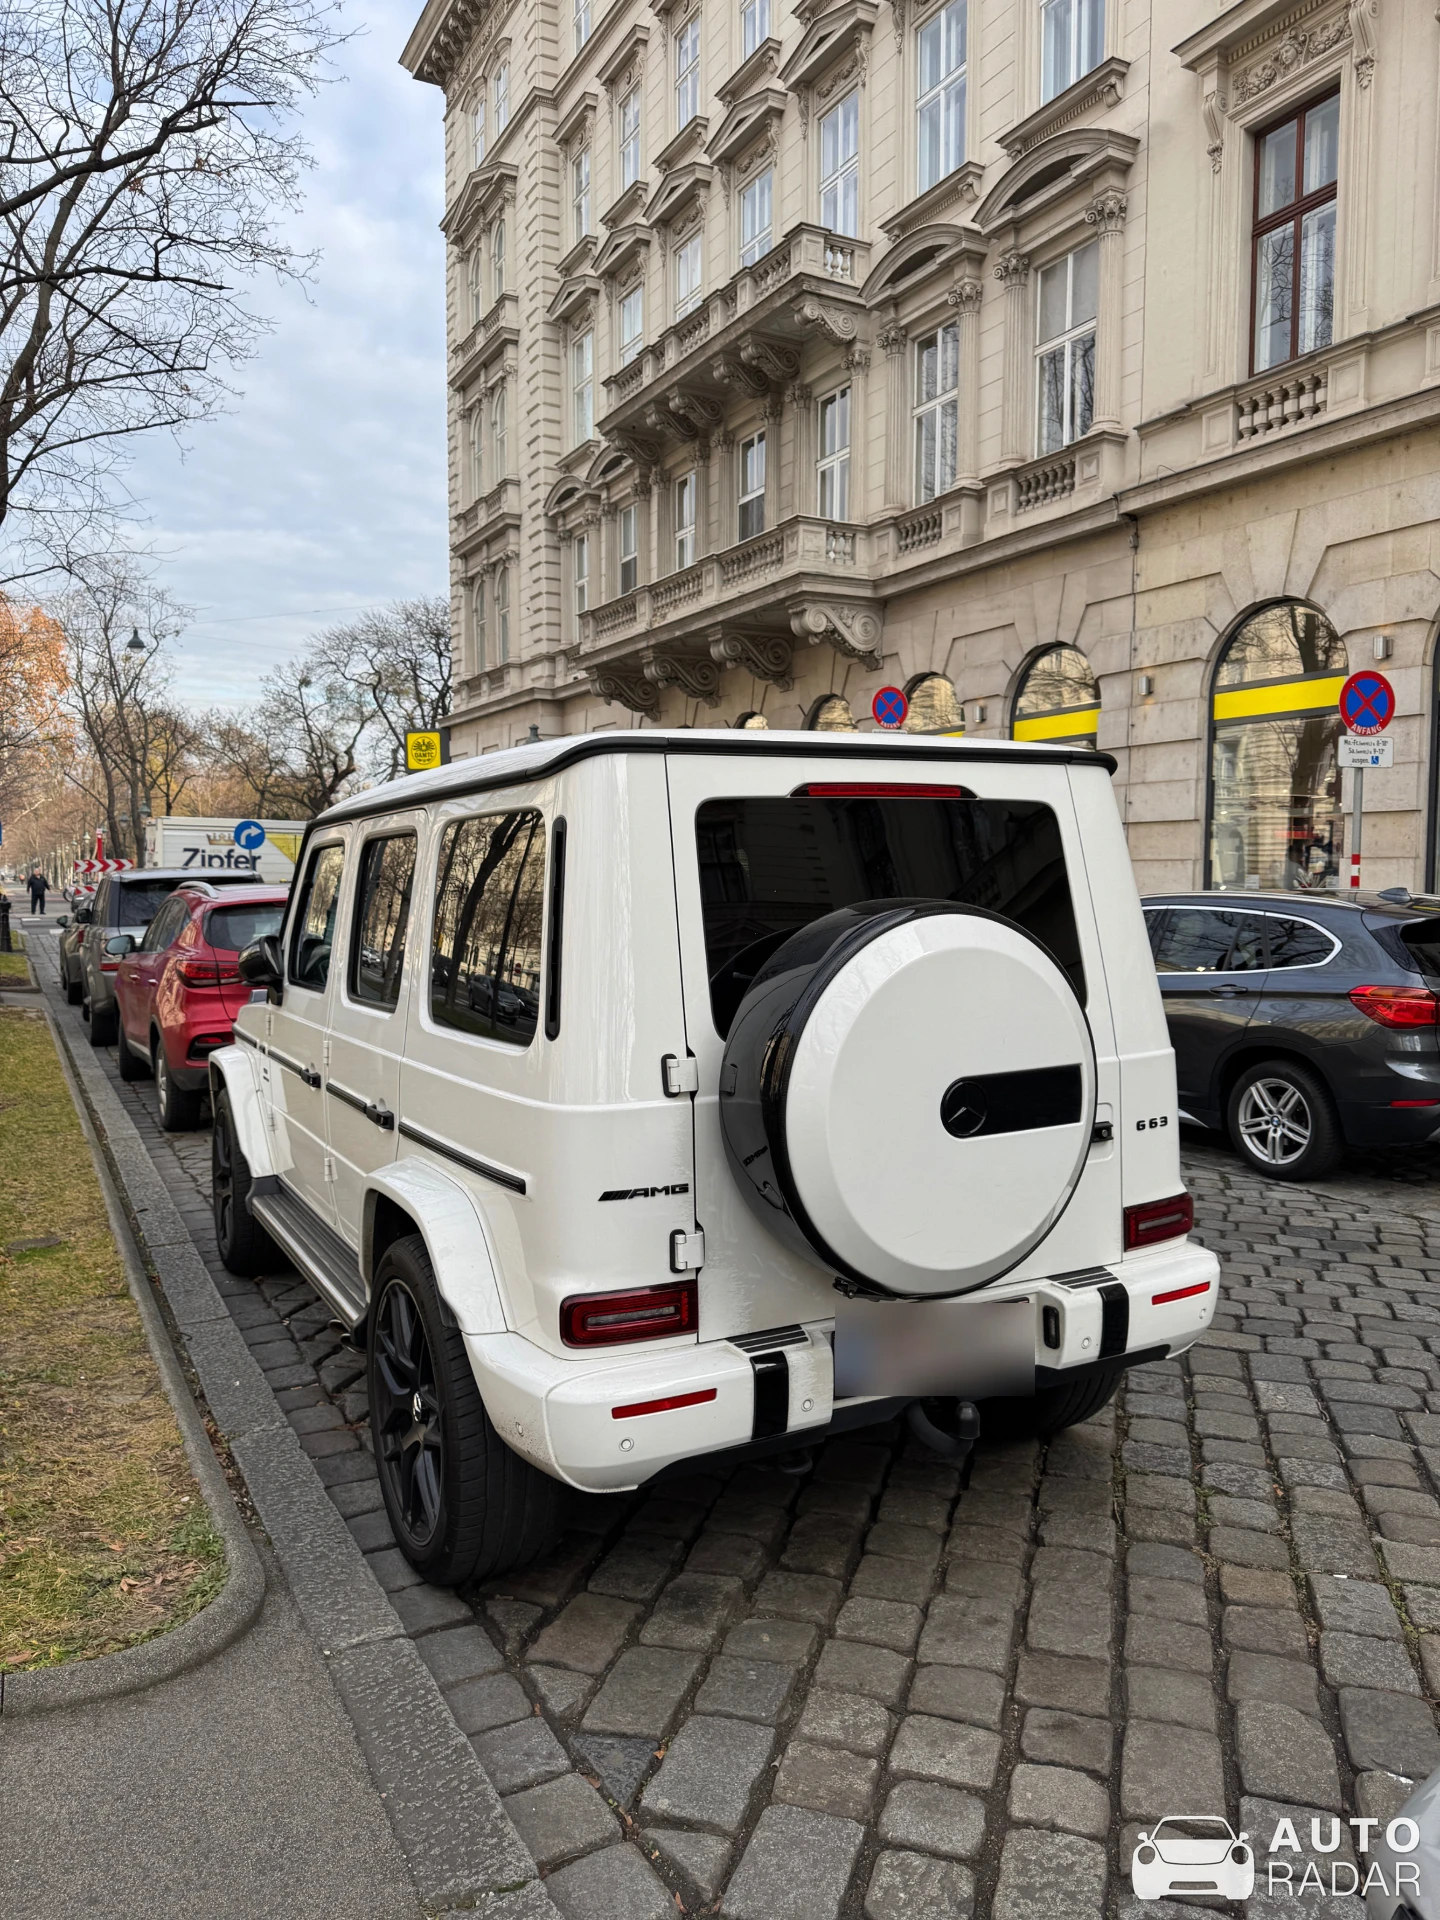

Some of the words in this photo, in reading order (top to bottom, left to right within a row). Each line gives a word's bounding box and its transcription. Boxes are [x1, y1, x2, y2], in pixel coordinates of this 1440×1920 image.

[1351, 723, 1382, 735] ANFANG
[182, 847, 262, 870] Zipfer
[628, 1183, 689, 1199] AMG
